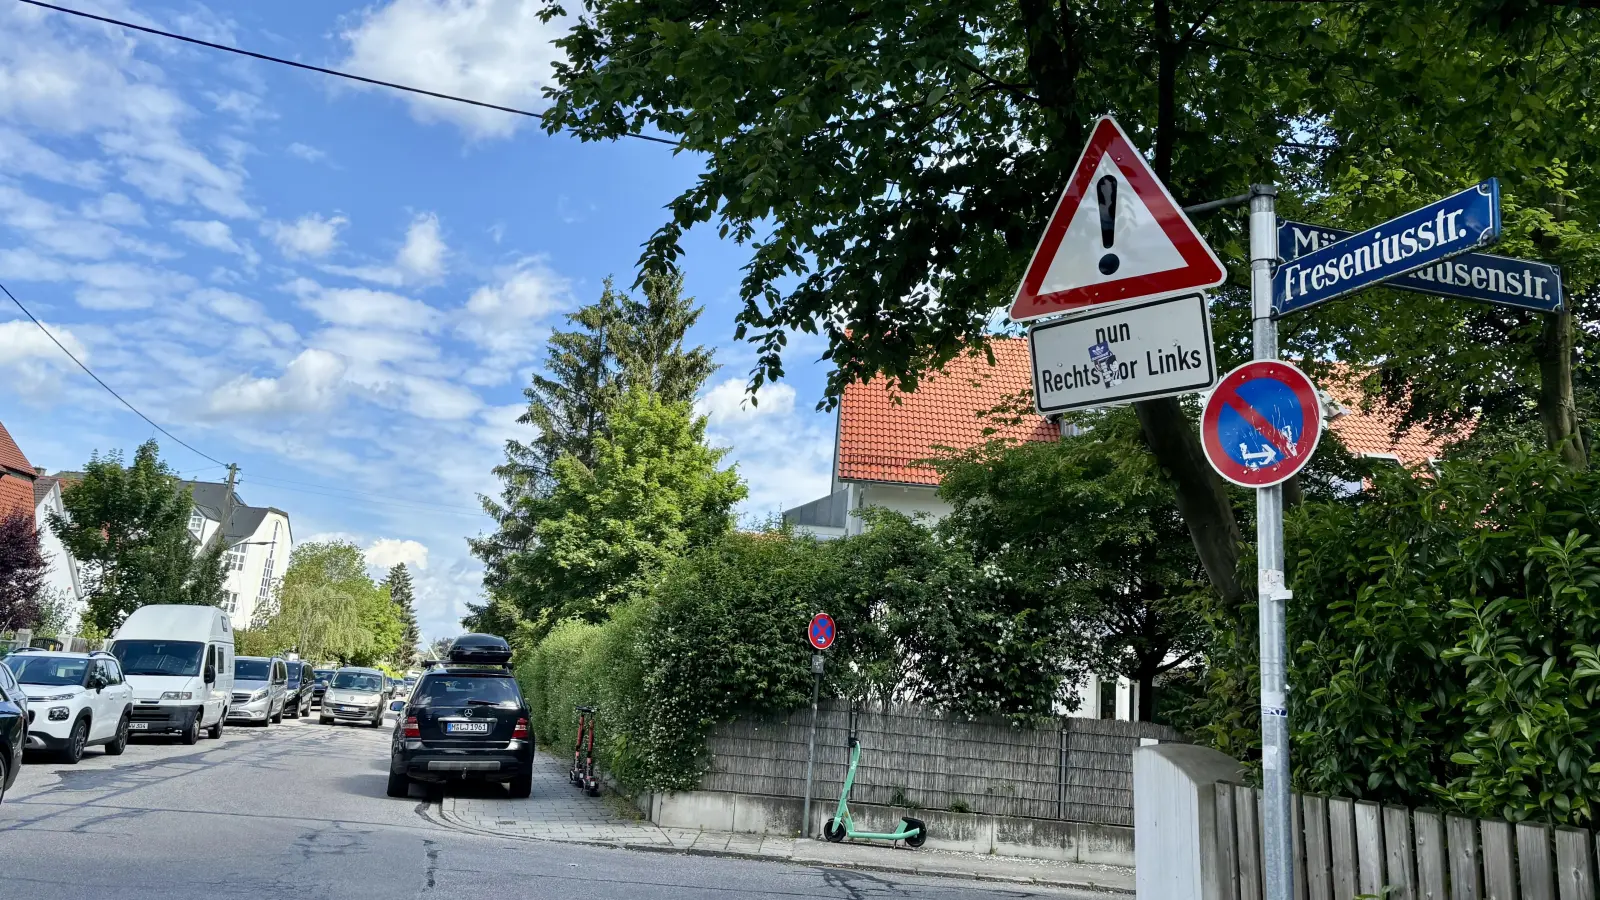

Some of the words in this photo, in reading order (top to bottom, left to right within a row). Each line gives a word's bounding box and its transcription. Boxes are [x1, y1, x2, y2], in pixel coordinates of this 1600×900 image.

[1284, 208, 1467, 301] Freseniusstr.
[1095, 322, 1131, 344] nun
[1042, 364, 1100, 394] Rechts
[1146, 345, 1202, 376] Links
[470, 723, 487, 731] 1961
